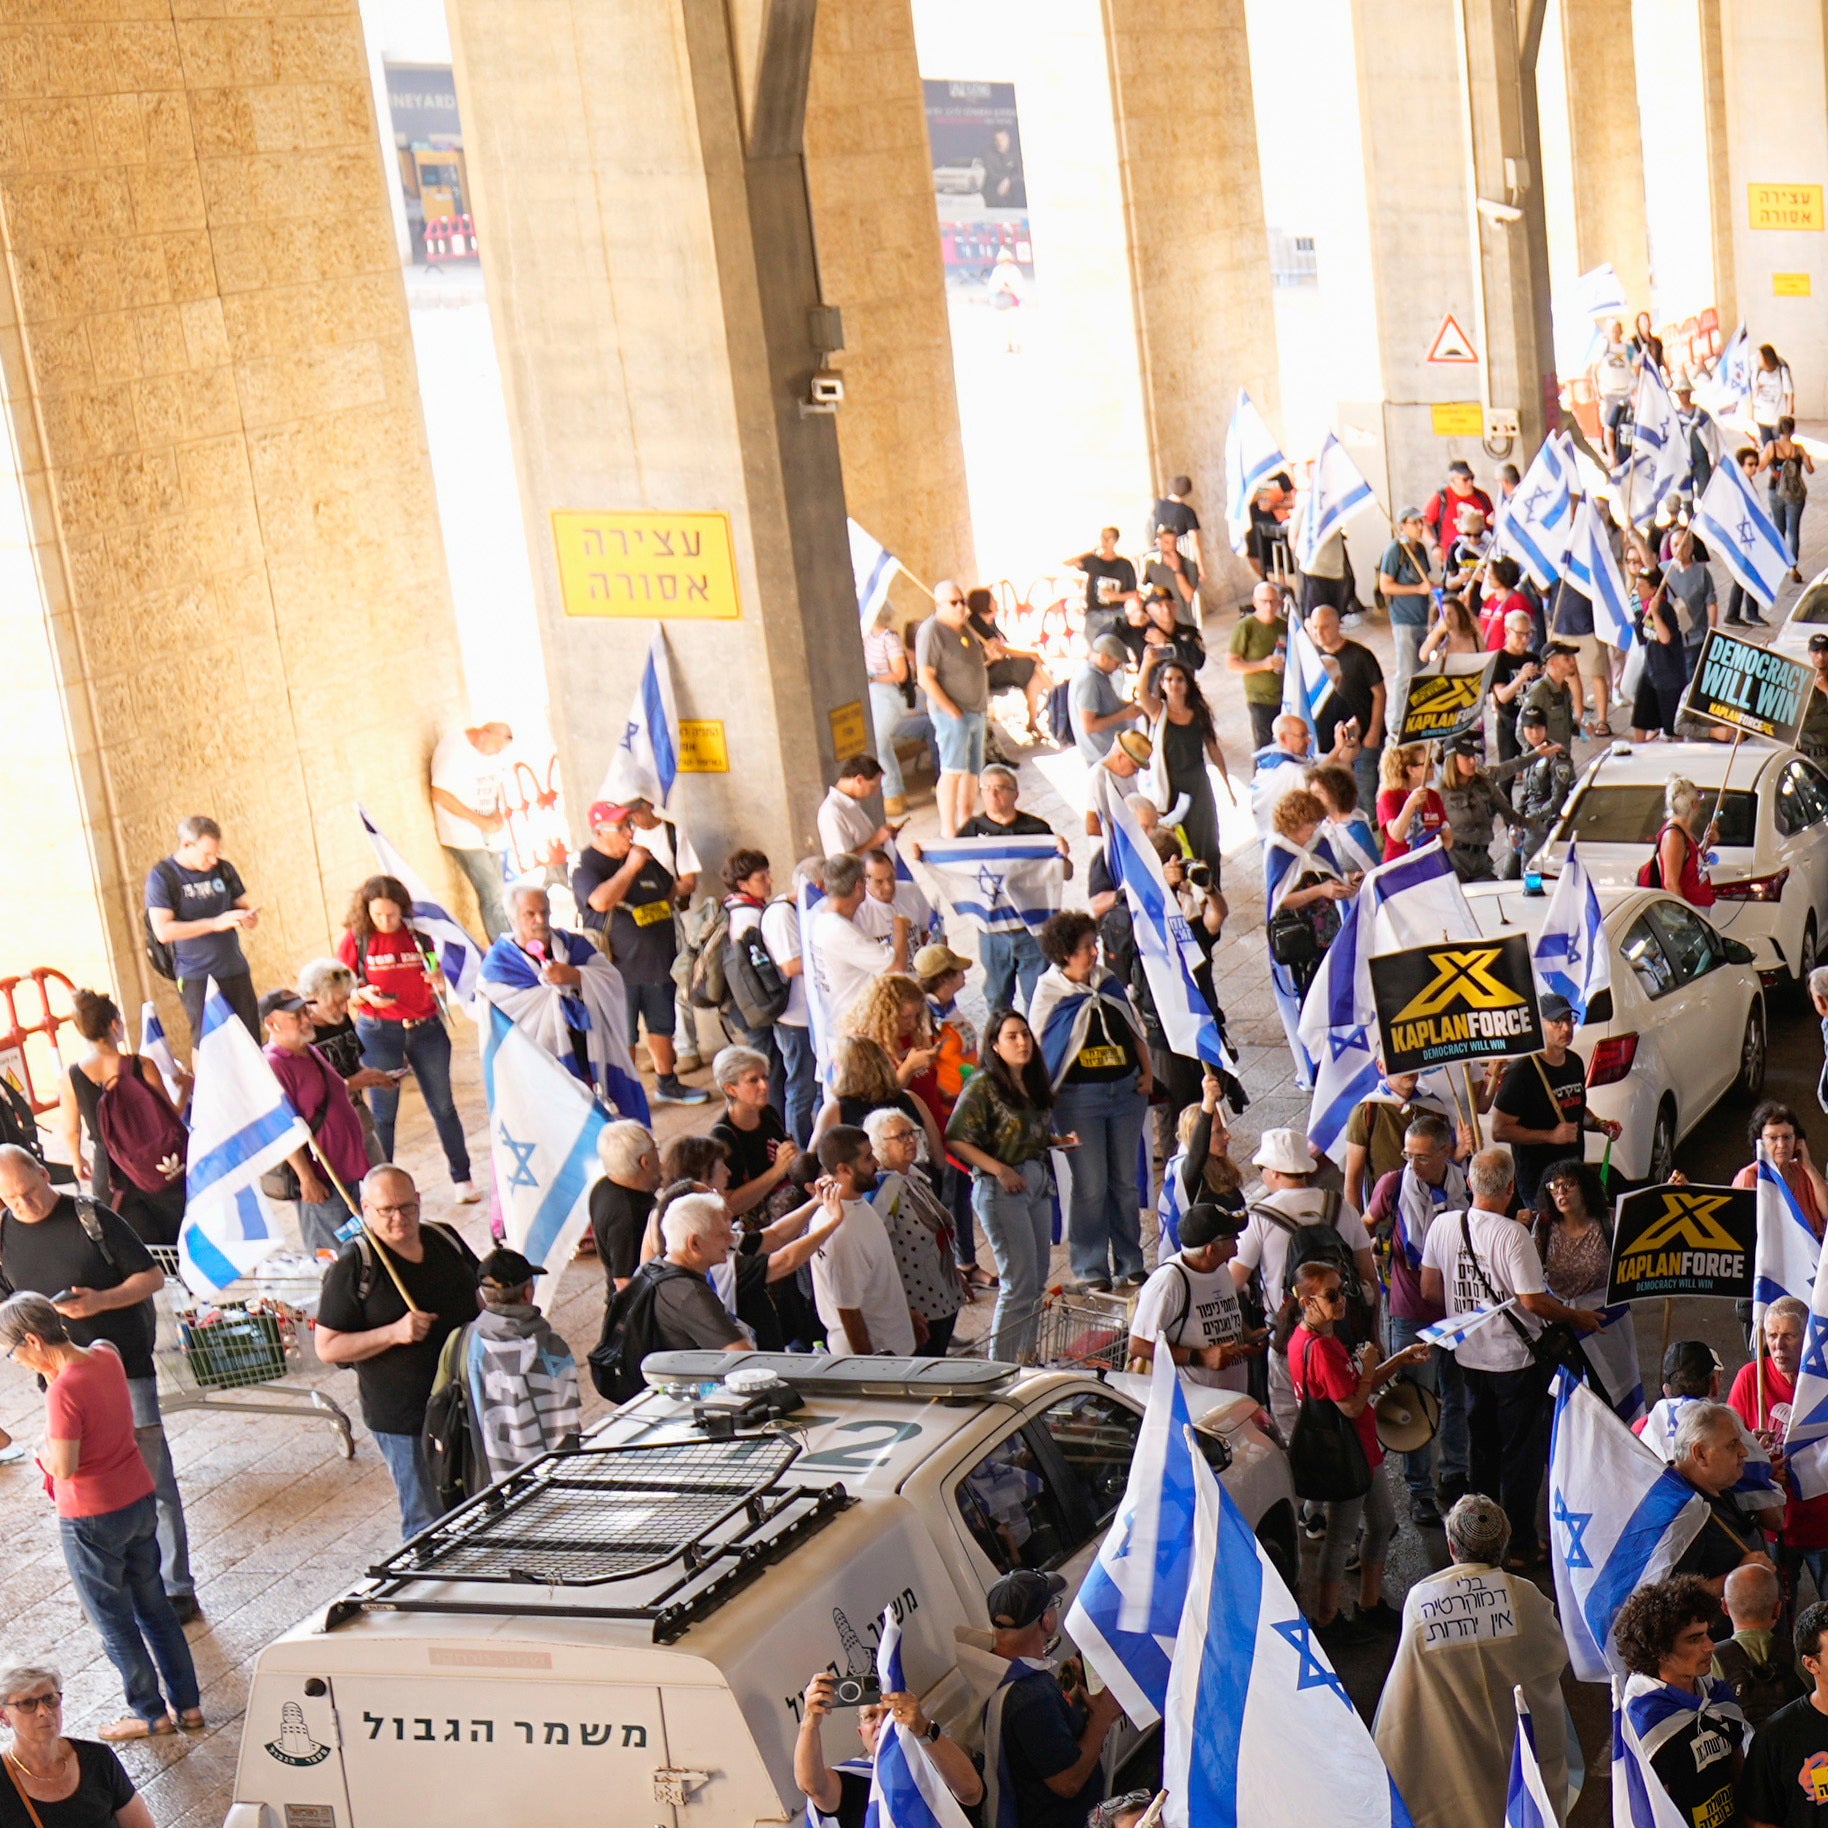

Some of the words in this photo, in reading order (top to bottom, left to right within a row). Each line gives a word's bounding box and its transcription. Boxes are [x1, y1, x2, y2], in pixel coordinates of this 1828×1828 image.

[1760, 191, 1811, 204] עצירה
[1760, 210, 1812, 223] אסורה
[581, 527, 702, 557] עצירה
[586, 573, 709, 602] אסורה
[1708, 634, 1812, 688] DEMOCRACY
[1700, 660, 1751, 710] WILL
[1755, 679, 1801, 727] WIN
[1390, 1007, 1533, 1052] KAPLANFORCE
[1422, 1042, 1469, 1062] DEMOCRACY
[1470, 1040, 1493, 1056] WILL
[1494, 1038, 1507, 1053] WIN
[1616, 1254, 1745, 1286] KAPLANFORCE
[1636, 1278, 1677, 1291] DEMOCRACY
[1678, 1278, 1698, 1290] WILL
[1699, 1278, 1713, 1290] WIN
[1456, 1576, 1488, 1594] בלי
[1420, 1588, 1509, 1620] דמוקרטיה
[1425, 1616, 1479, 1643] יהדות
[1490, 1608, 1515, 1638] אין
[363, 1720, 495, 1744] הגבול
[514, 1730, 650, 1749] משמר
